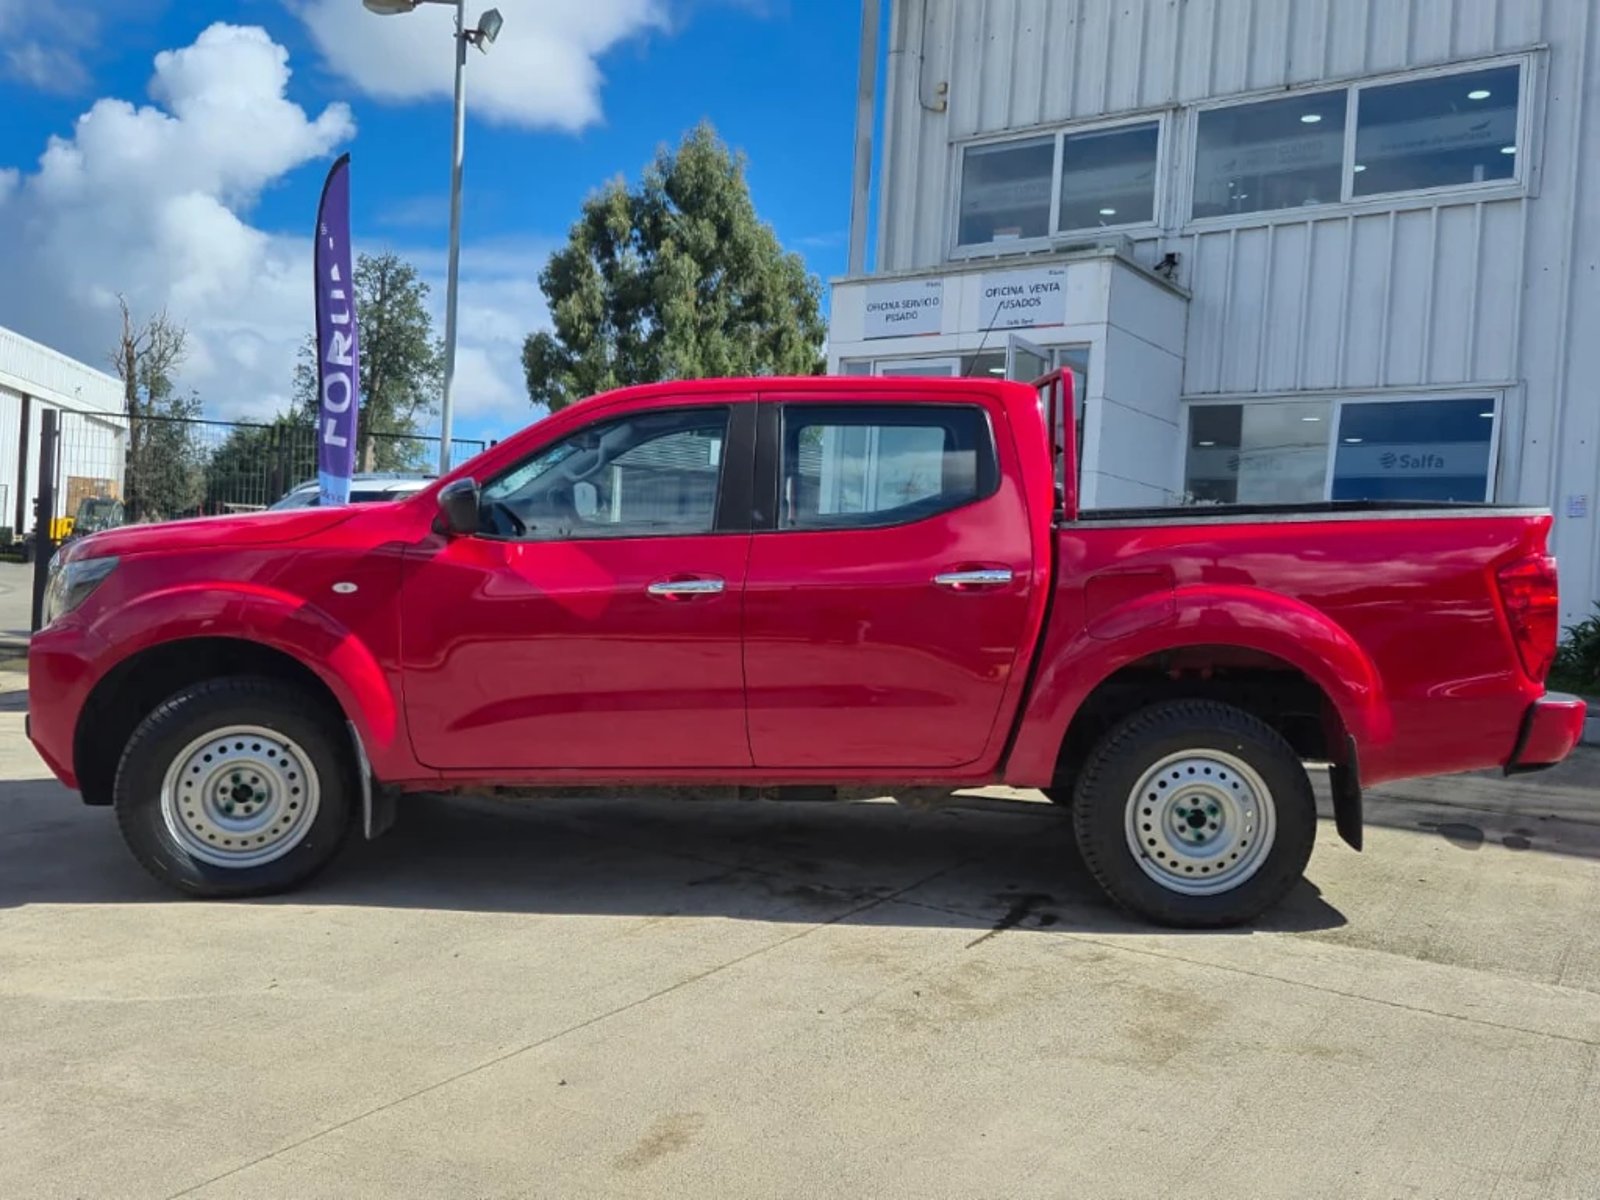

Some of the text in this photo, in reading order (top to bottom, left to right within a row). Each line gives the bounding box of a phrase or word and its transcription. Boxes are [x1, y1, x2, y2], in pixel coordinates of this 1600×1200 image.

[985, 283, 1061, 297] OFICINA VENTA
[867, 297, 939, 313] OFICINA SERVICIO
[1001, 297, 1042, 309] USADOS
[1400, 453, 1444, 469] Salfa
